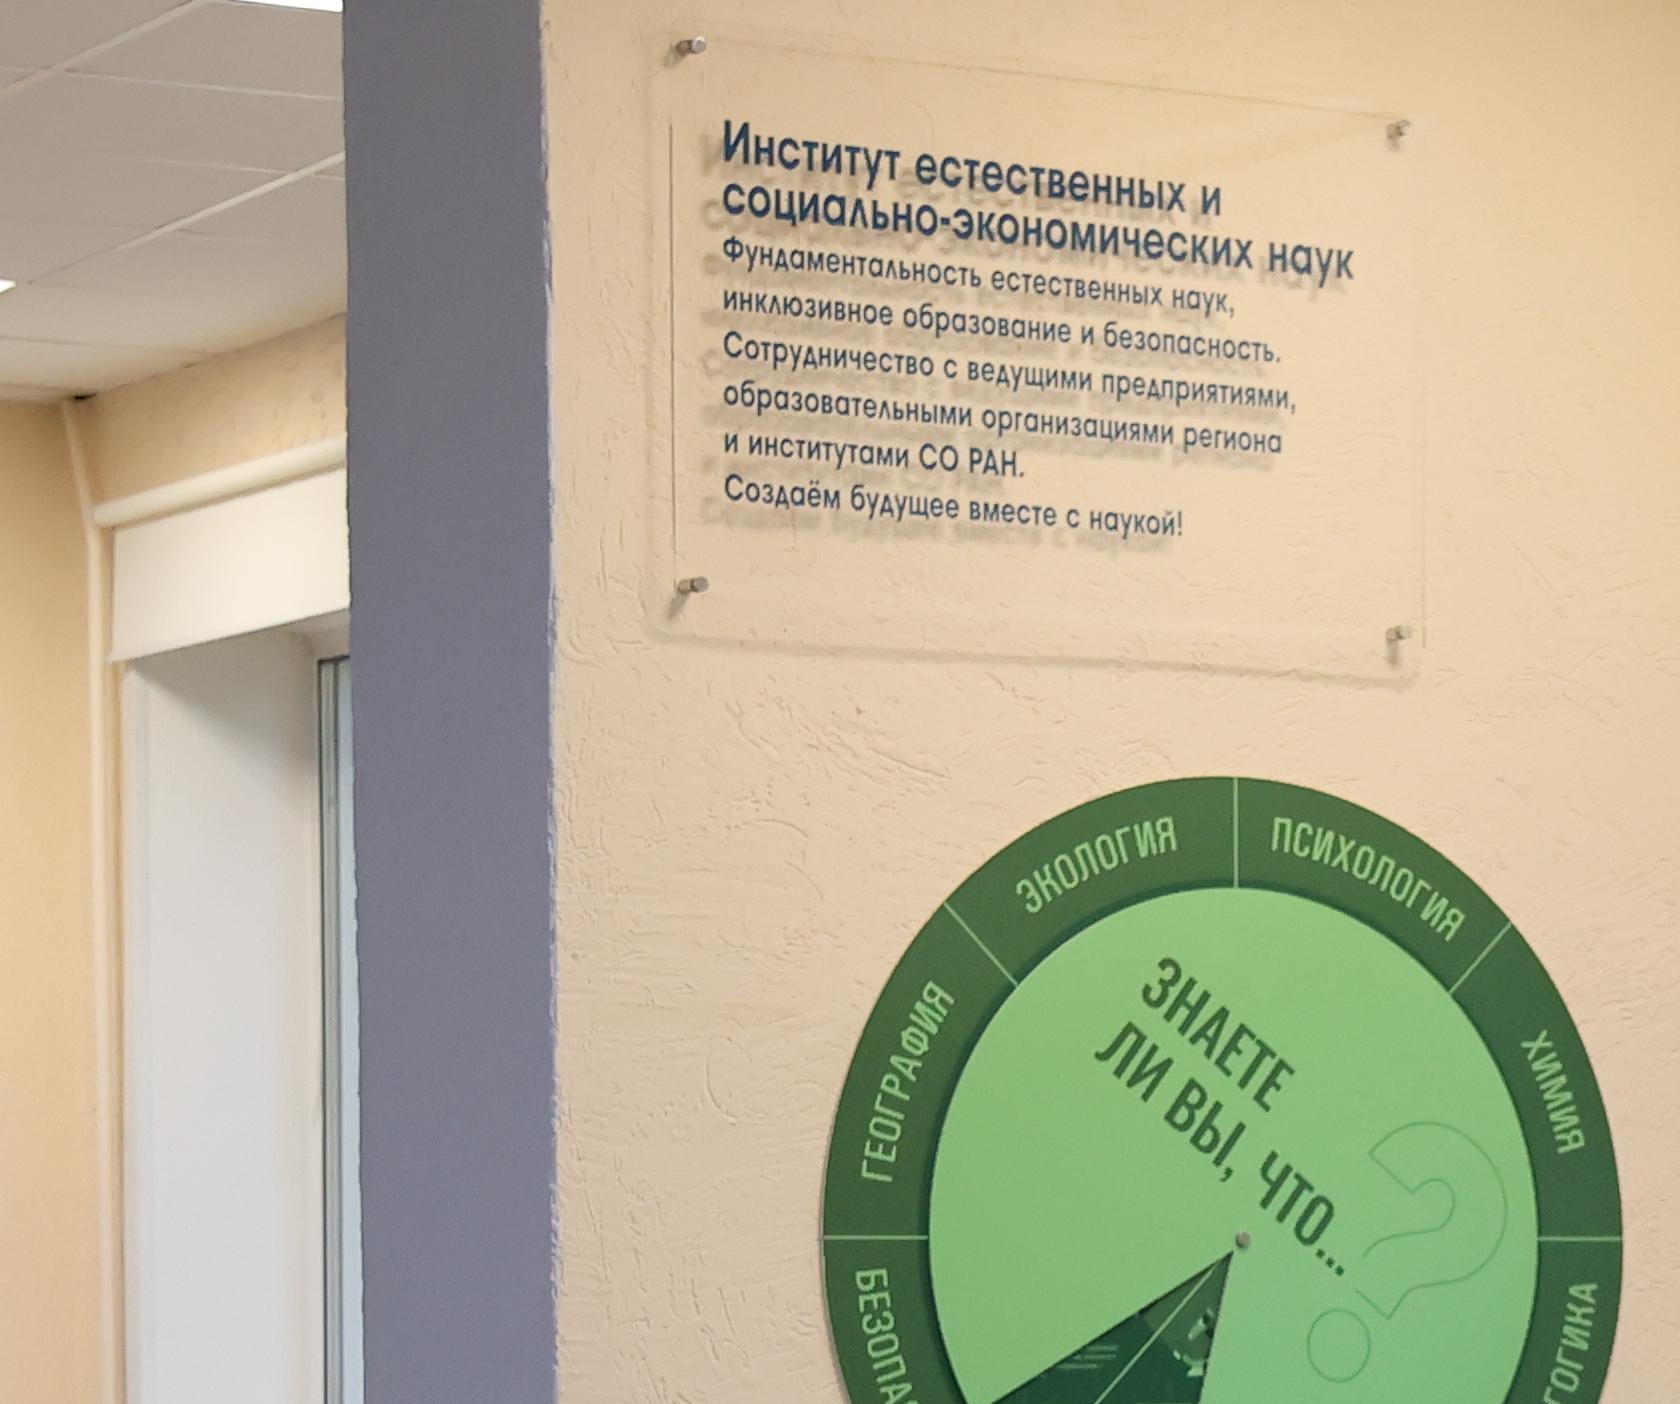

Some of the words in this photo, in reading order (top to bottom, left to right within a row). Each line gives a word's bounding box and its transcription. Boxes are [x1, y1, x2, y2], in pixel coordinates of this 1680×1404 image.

[723, 120, 900, 190] Институт
[916, 153, 1186, 212] естественных
[1201, 186, 1221, 216] и
[723, 183, 1253, 268] социально-экономических
[1269, 242, 1354, 288] наук
[723, 236, 981, 288] Фундаментальность
[992, 270, 1162, 306] естественных
[1172, 290, 1235, 318] наук,
[723, 290, 893, 325] инклюзивное
[903, 303, 1071, 341] образование
[1081, 325, 1094, 345] и
[1103, 321, 1281, 363] безопасность.
[724, 331, 934, 377] Сотрудничество
[944, 358, 958, 378] с
[969, 361, 1092, 391] ведущими
[1102, 373, 1296, 414] предприятиями,
[724, 380, 971, 427] образовательными
[981, 409, 1174, 444] организациями
[1184, 426, 1282, 454] региона
[724, 433, 738, 453] и
[749, 433, 908, 470] институтами
[920, 443, 958, 472] СО
[970, 447, 1025, 478] РАН.
[725, 474, 840, 509] Создаём
[851, 484, 959, 522] будущее
[970, 501, 1057, 526] вместе
[1066, 508, 1080, 528] с
[1090, 509, 1182, 540] наукой!
[1016, 815, 1178, 915] ЭКОЛОГИЯ
[1271, 816, 1466, 943] ПСИХОЛОГИЯ
[861, 979, 956, 1183] ГЕОГРАФИЯ
[1141, 957, 1296, 1113] ЗНАЕТЕ
[1521, 1028, 1586, 1155] ХИМИЯ
[1094, 1021, 1174, 1103] ЛИ
[1164, 1077, 1247, 1183] ВЫ,
[1259, 1150, 1345, 1277] ЧТО...
